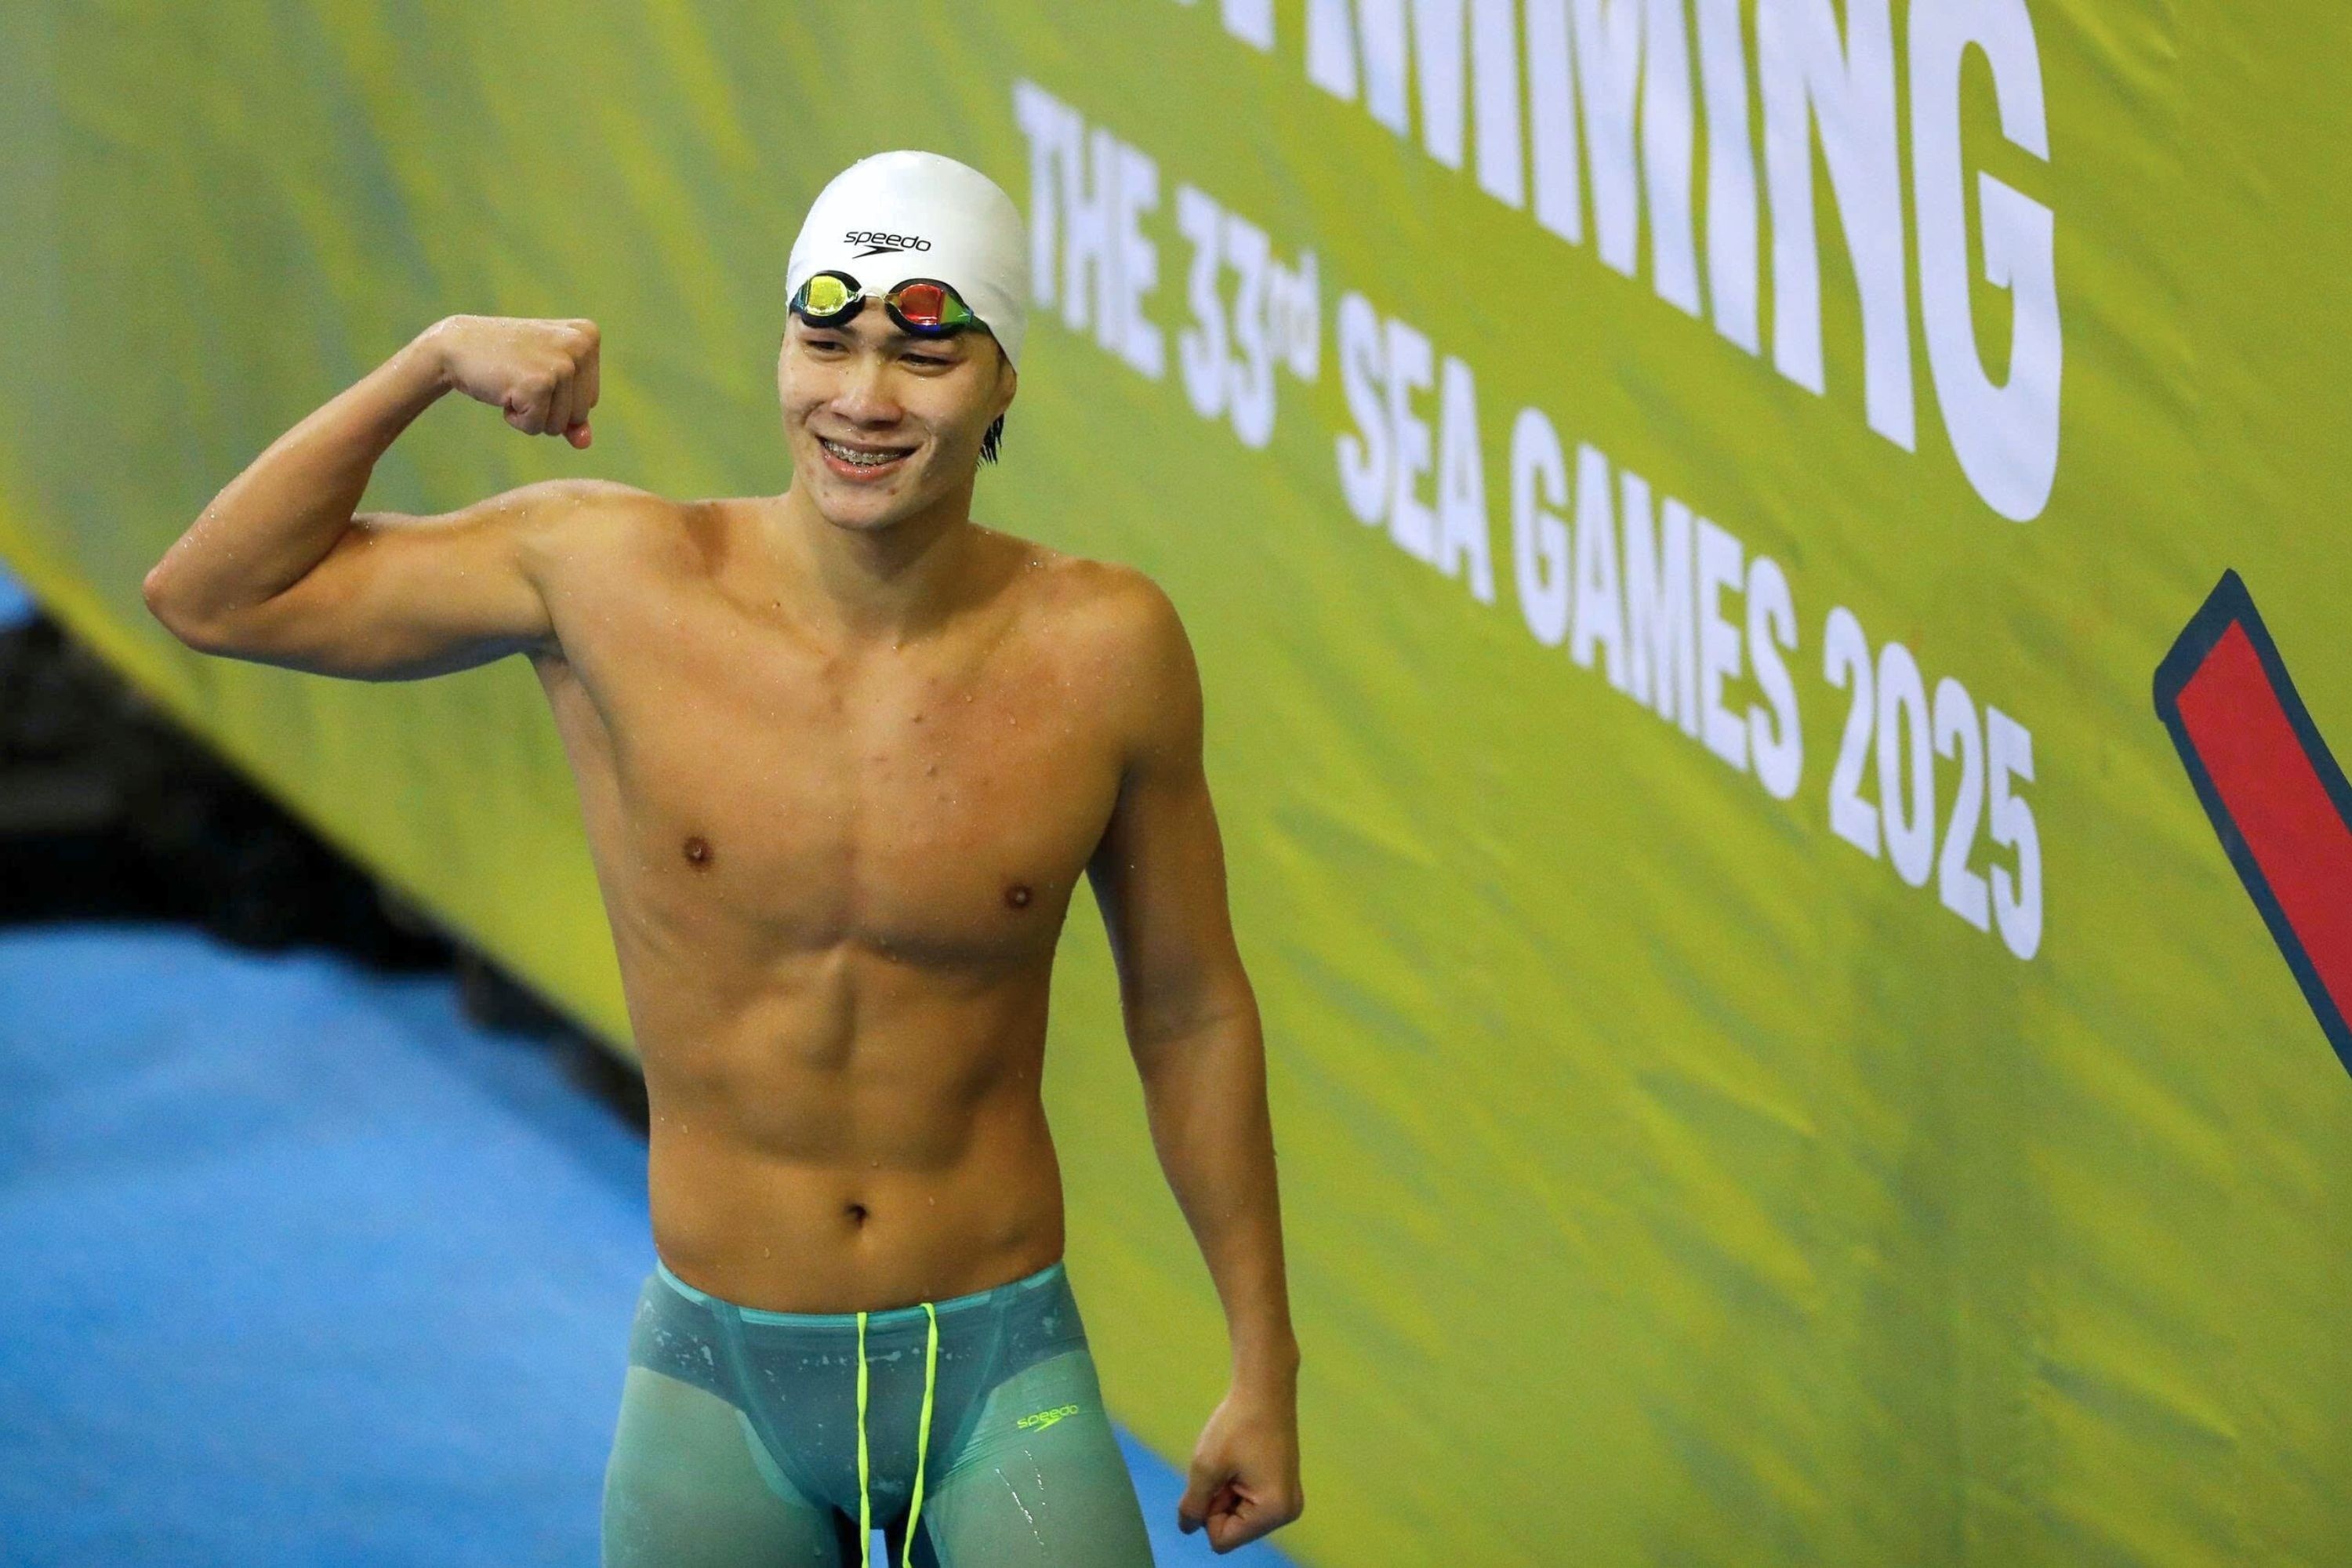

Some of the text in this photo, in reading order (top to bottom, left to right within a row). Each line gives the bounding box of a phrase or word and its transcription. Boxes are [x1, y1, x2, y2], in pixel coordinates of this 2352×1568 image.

[844, 231, 931, 252] speedo
[1014, 79, 2042, 960] THE 33rd SEA GAMES 2025
[1017, 1404, 1079, 1428] speedo
